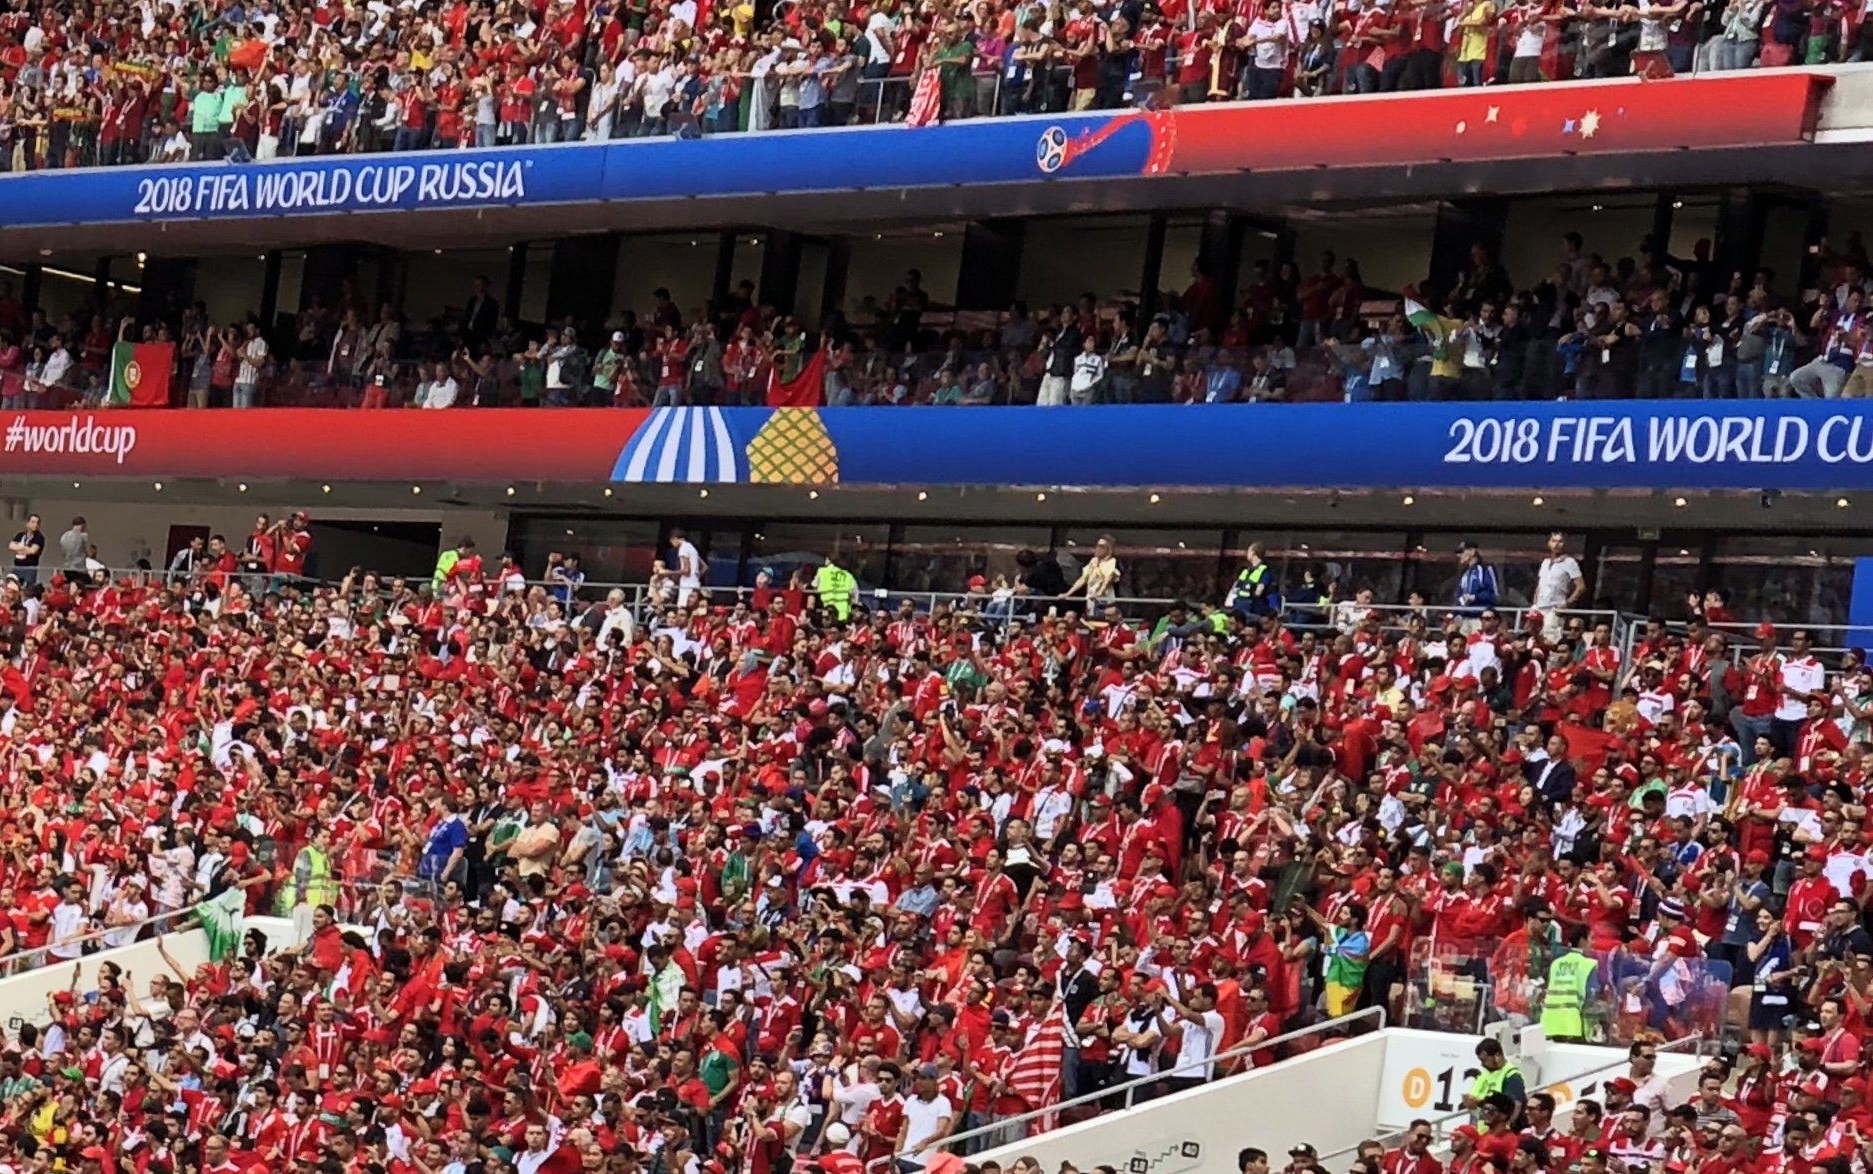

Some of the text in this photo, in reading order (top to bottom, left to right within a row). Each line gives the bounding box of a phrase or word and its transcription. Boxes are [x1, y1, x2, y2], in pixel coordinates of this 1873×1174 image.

[134, 177, 191, 213] 2018
[195, 174, 248, 211] FIFA
[255, 168, 350, 209] WORLD
[355, 165, 414, 204] CUP
[4, 415, 137, 464] #worldcup
[1444, 418, 1540, 463] 2018
[1546, 417, 1636, 463] FIFA
[1648, 416, 1809, 463] WORLD
